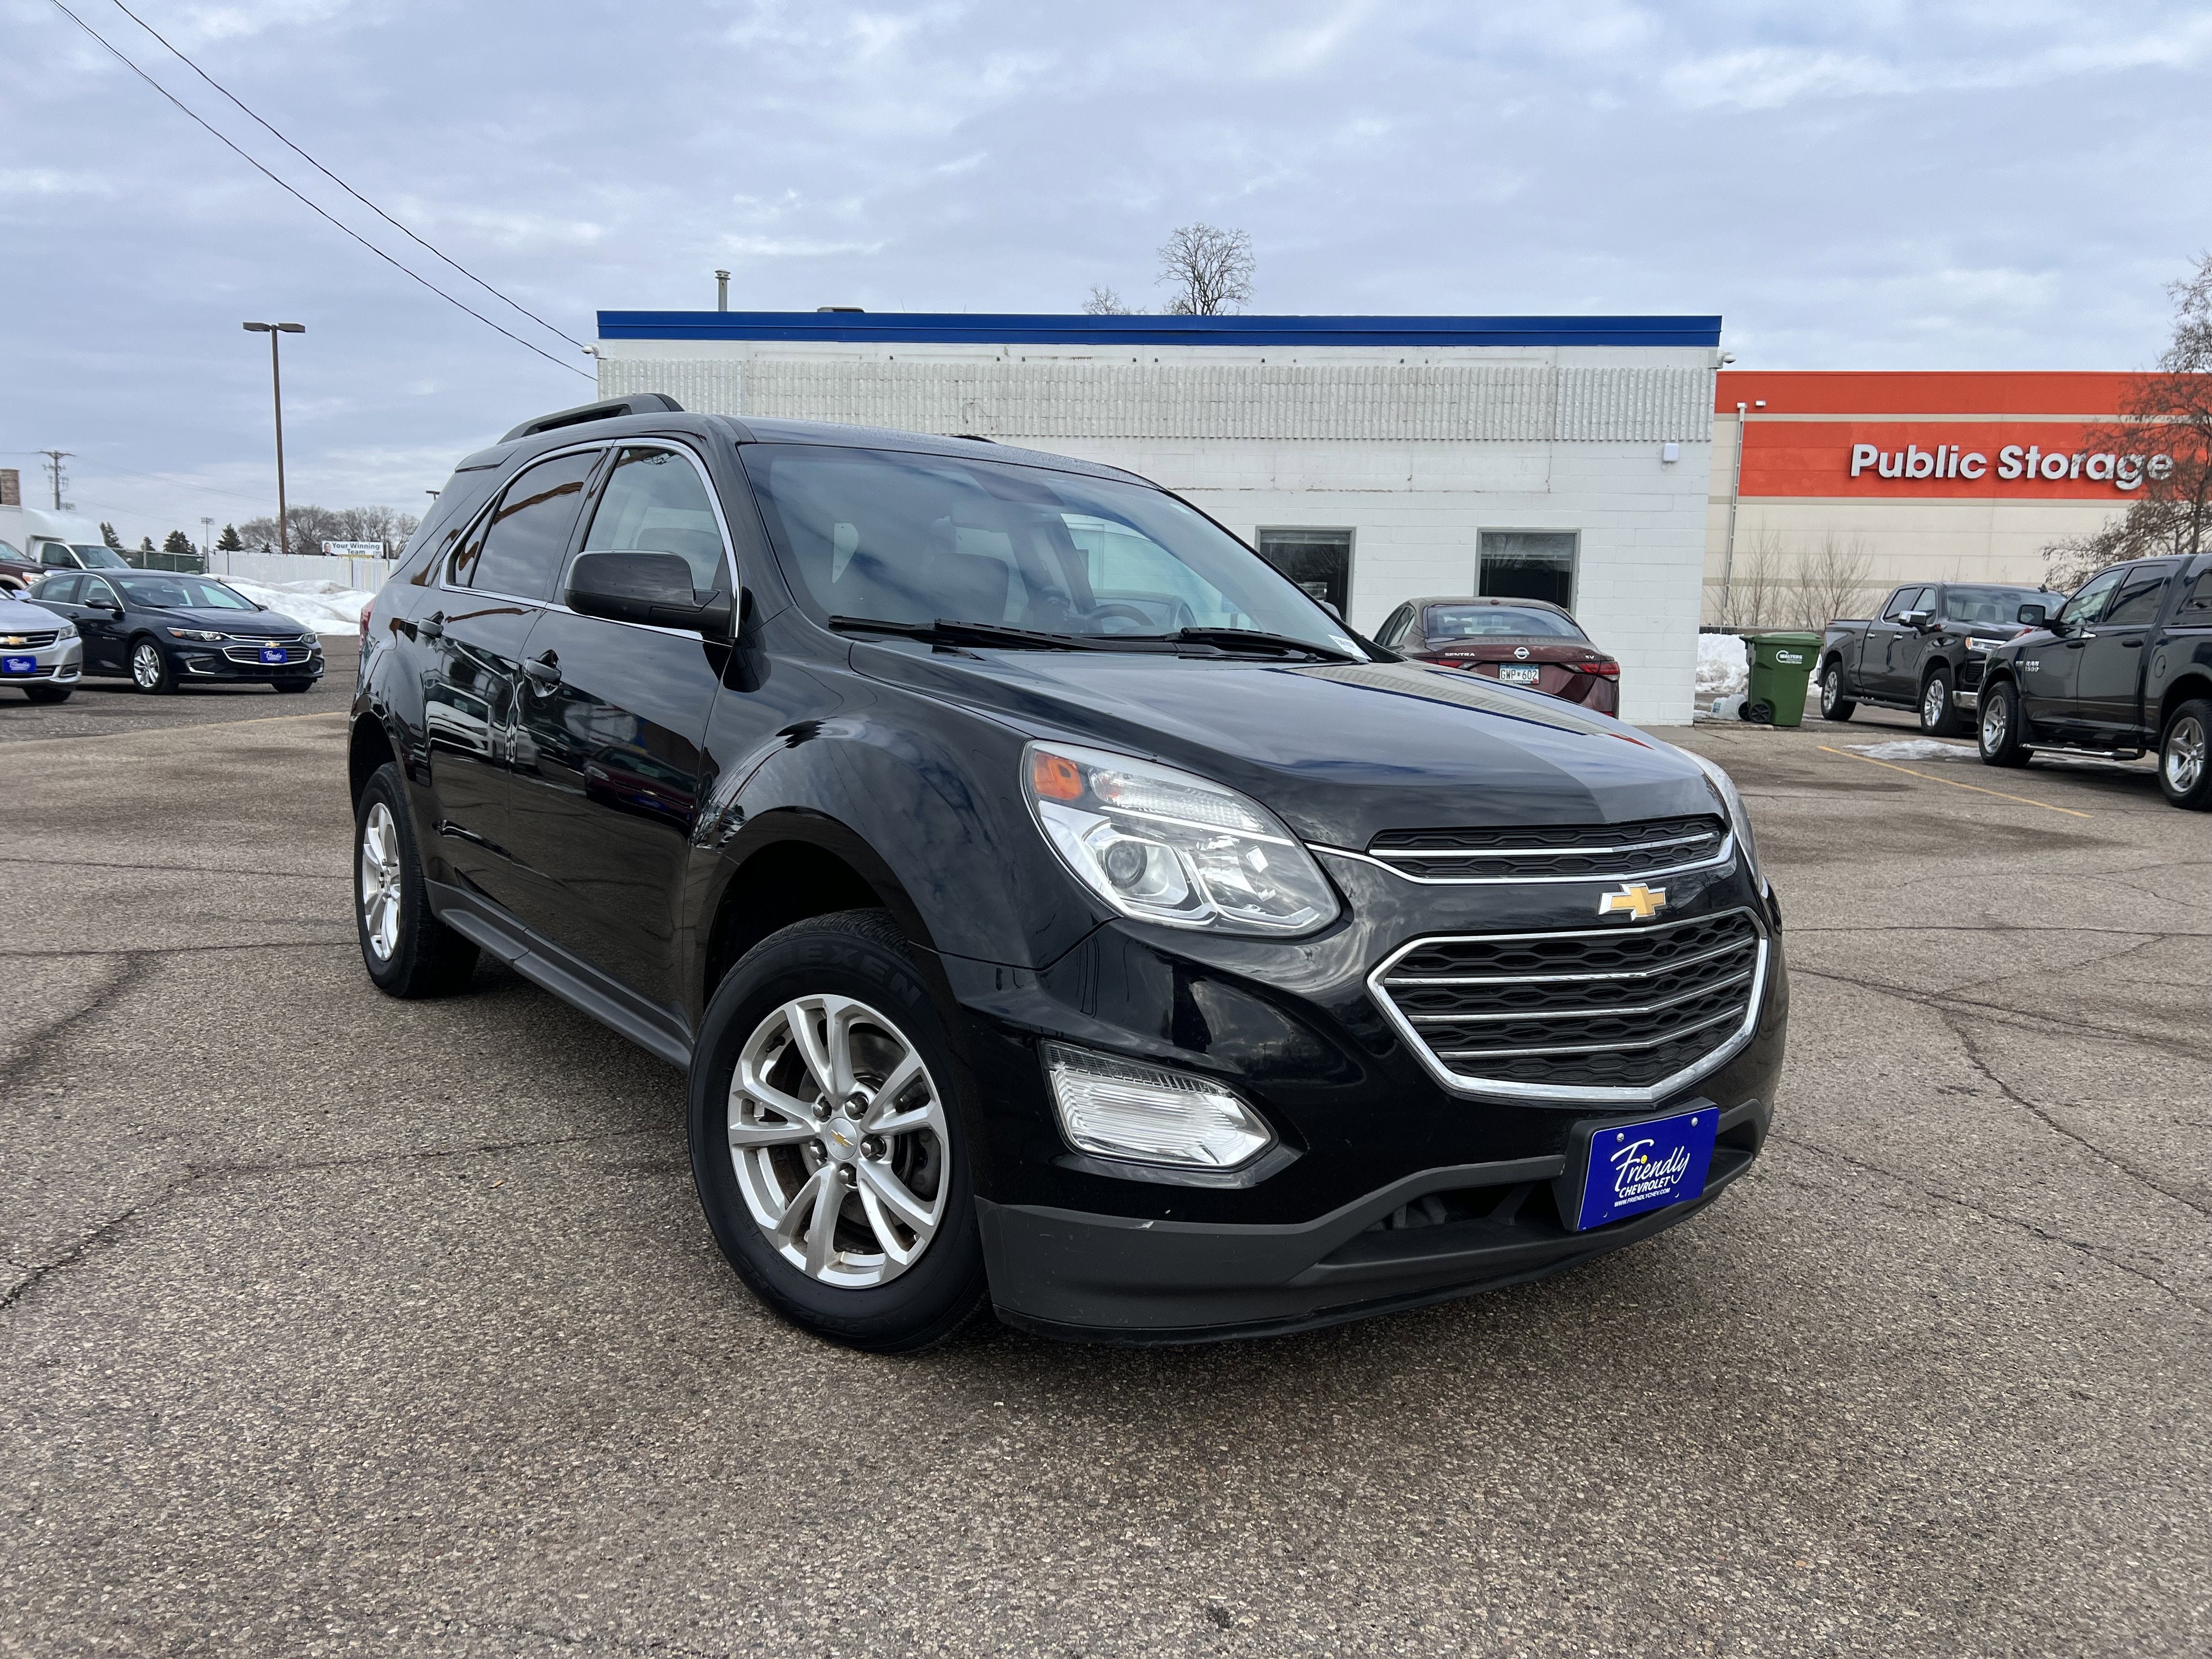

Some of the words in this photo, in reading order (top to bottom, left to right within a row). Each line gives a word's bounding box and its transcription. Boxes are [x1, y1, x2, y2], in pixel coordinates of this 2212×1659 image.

[1850, 443, 1987, 479] Public
[1997, 444, 2174, 490] Storage
[350, 542, 380, 550] Winning
[1501, 669, 1516, 680] GWP
[1522, 670, 1537, 680] 602
[1610, 1139, 1690, 1192] Friendly
[1619, 1176, 1671, 1198] CHEVROLET
